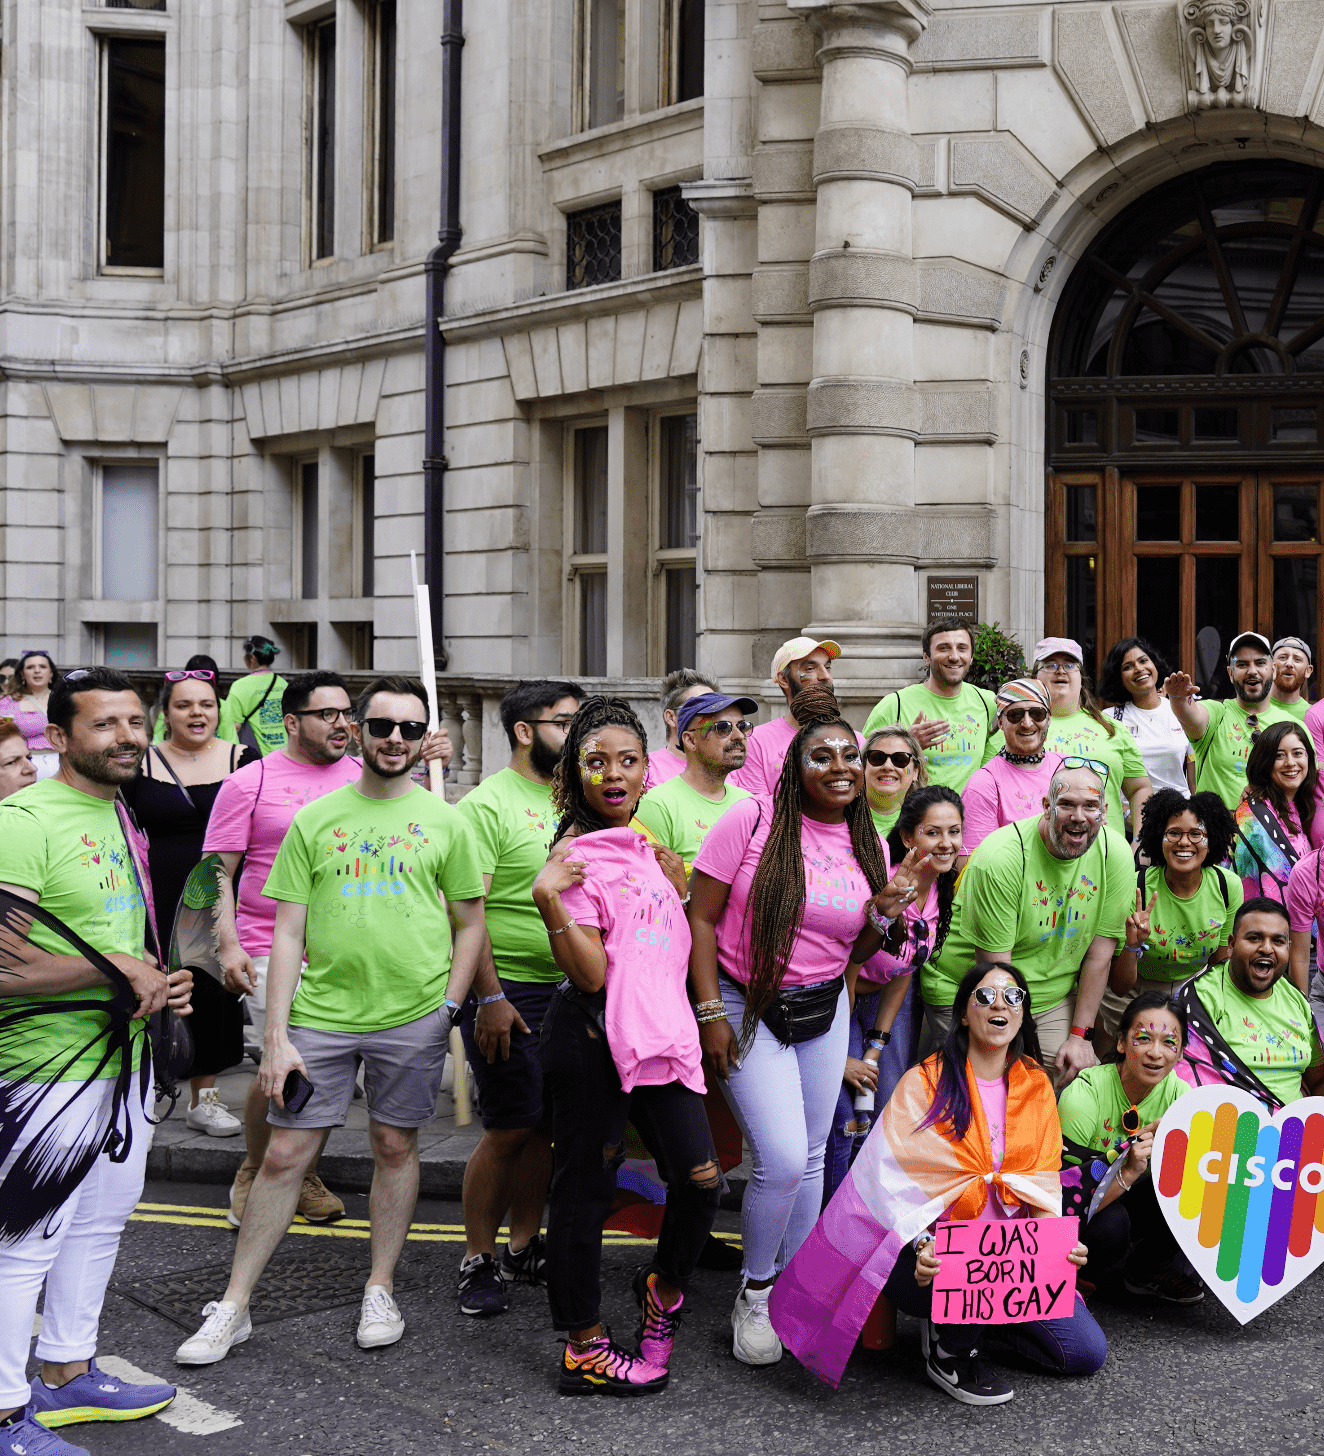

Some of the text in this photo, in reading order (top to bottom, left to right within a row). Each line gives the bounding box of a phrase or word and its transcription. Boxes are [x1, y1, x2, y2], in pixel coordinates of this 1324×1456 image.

[932, 755, 972, 766] CISCO
[341, 880, 405, 897] CISCO
[802, 891, 859, 912] ISCO
[936, 1221, 1038, 1257] I WAS
[966, 1258, 1035, 1285] BORN
[935, 1279, 1067, 1321] THIS GAY
